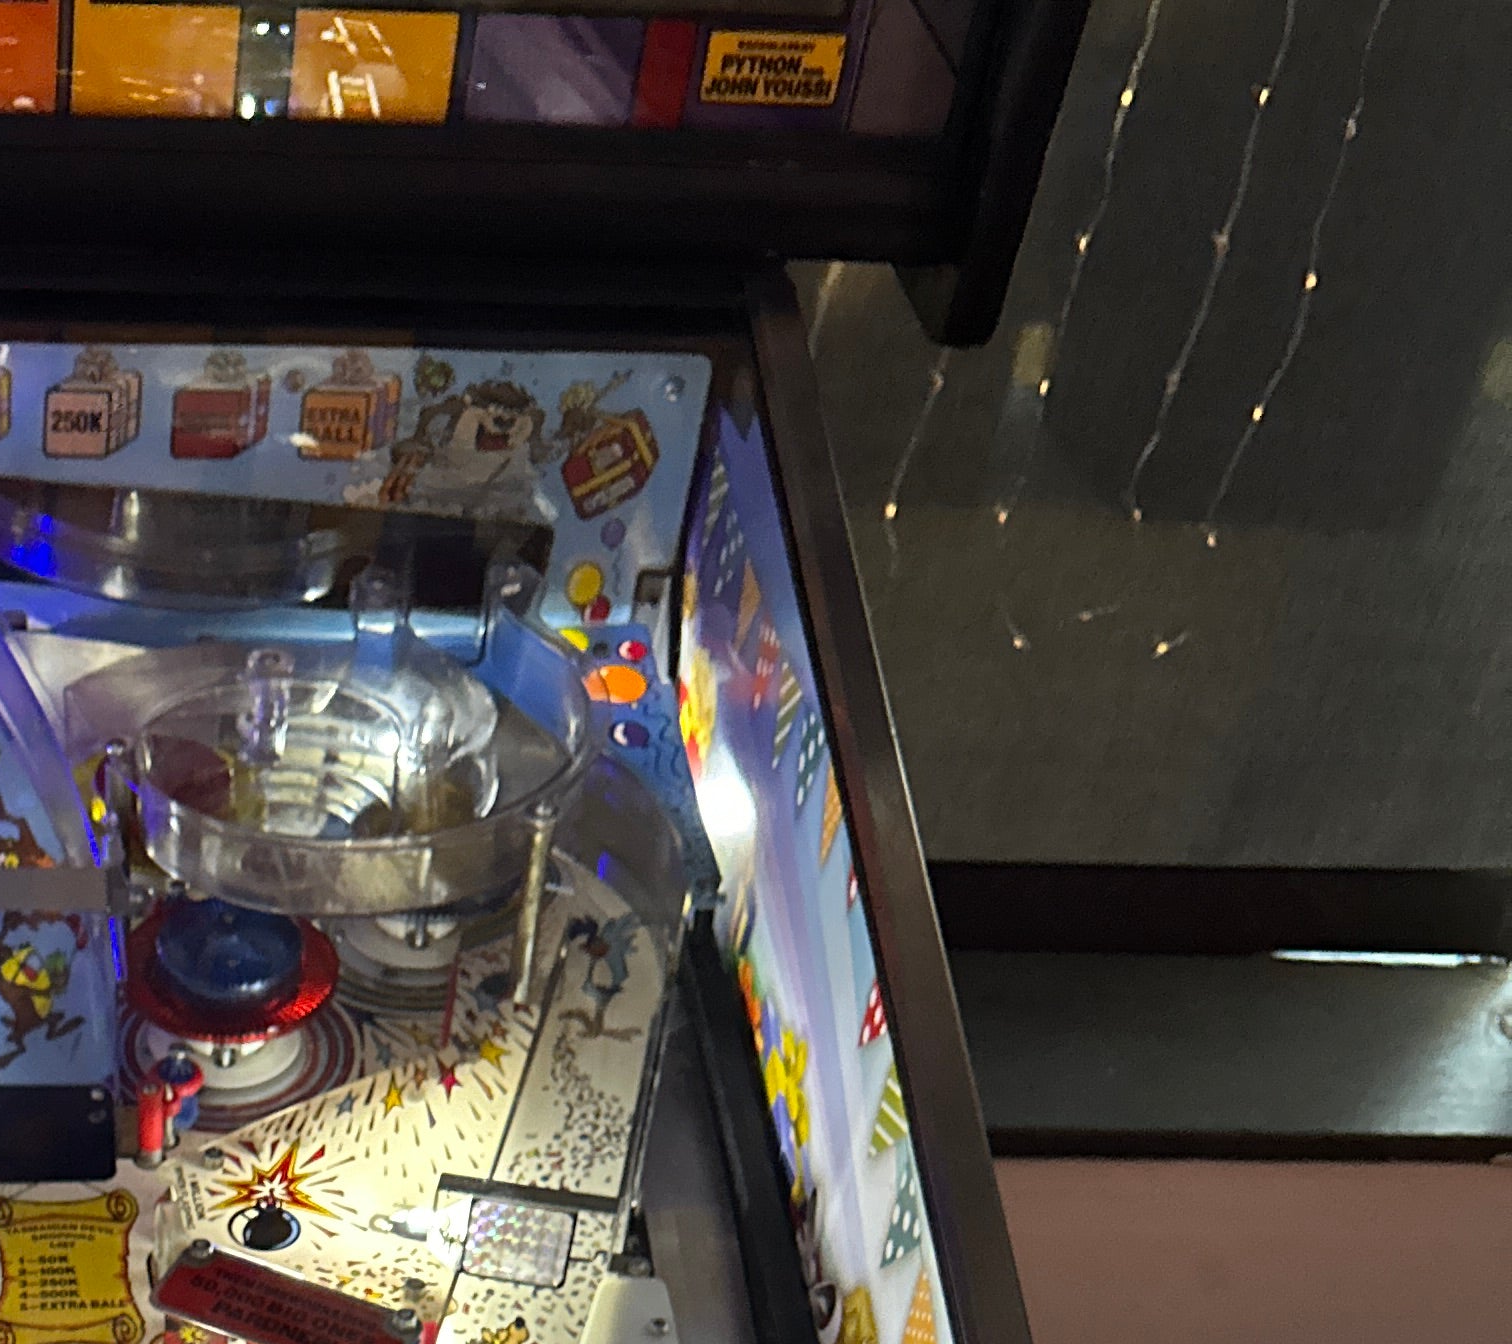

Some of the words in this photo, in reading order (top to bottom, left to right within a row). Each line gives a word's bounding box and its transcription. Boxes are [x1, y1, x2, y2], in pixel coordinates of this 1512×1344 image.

[721, 54, 802, 74] PYTHON
[705, 78, 758, 95] JOHN
[764, 78, 833, 97] YOUSSI
[51, 409, 103, 433] 250K
